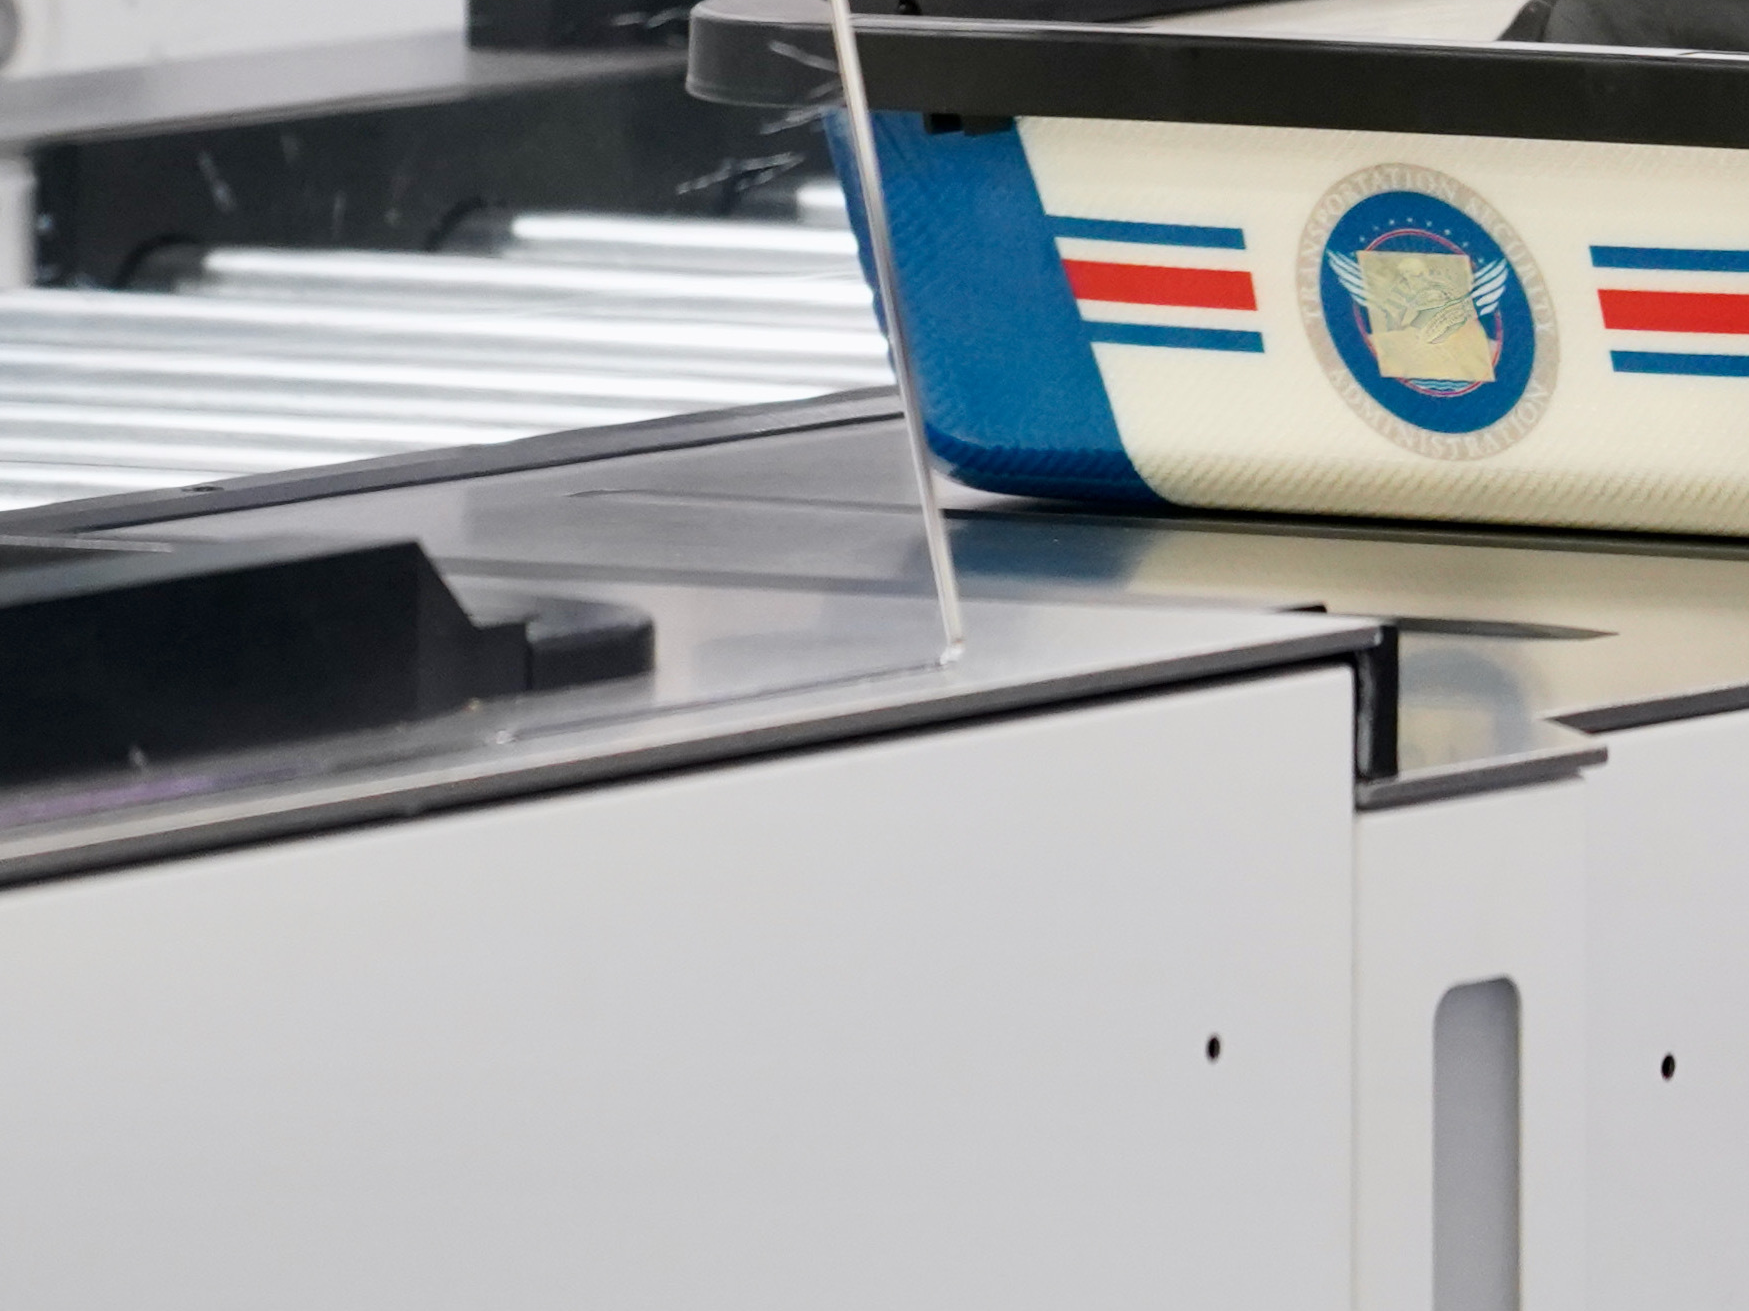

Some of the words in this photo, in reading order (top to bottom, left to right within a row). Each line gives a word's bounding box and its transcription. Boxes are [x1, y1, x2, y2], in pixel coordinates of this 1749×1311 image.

[1301, 168, 1457, 319] TRANSPORTATION
[1465, 196, 1554, 331] SECURITY
[1328, 369, 1551, 459] ADMINISTRATION
